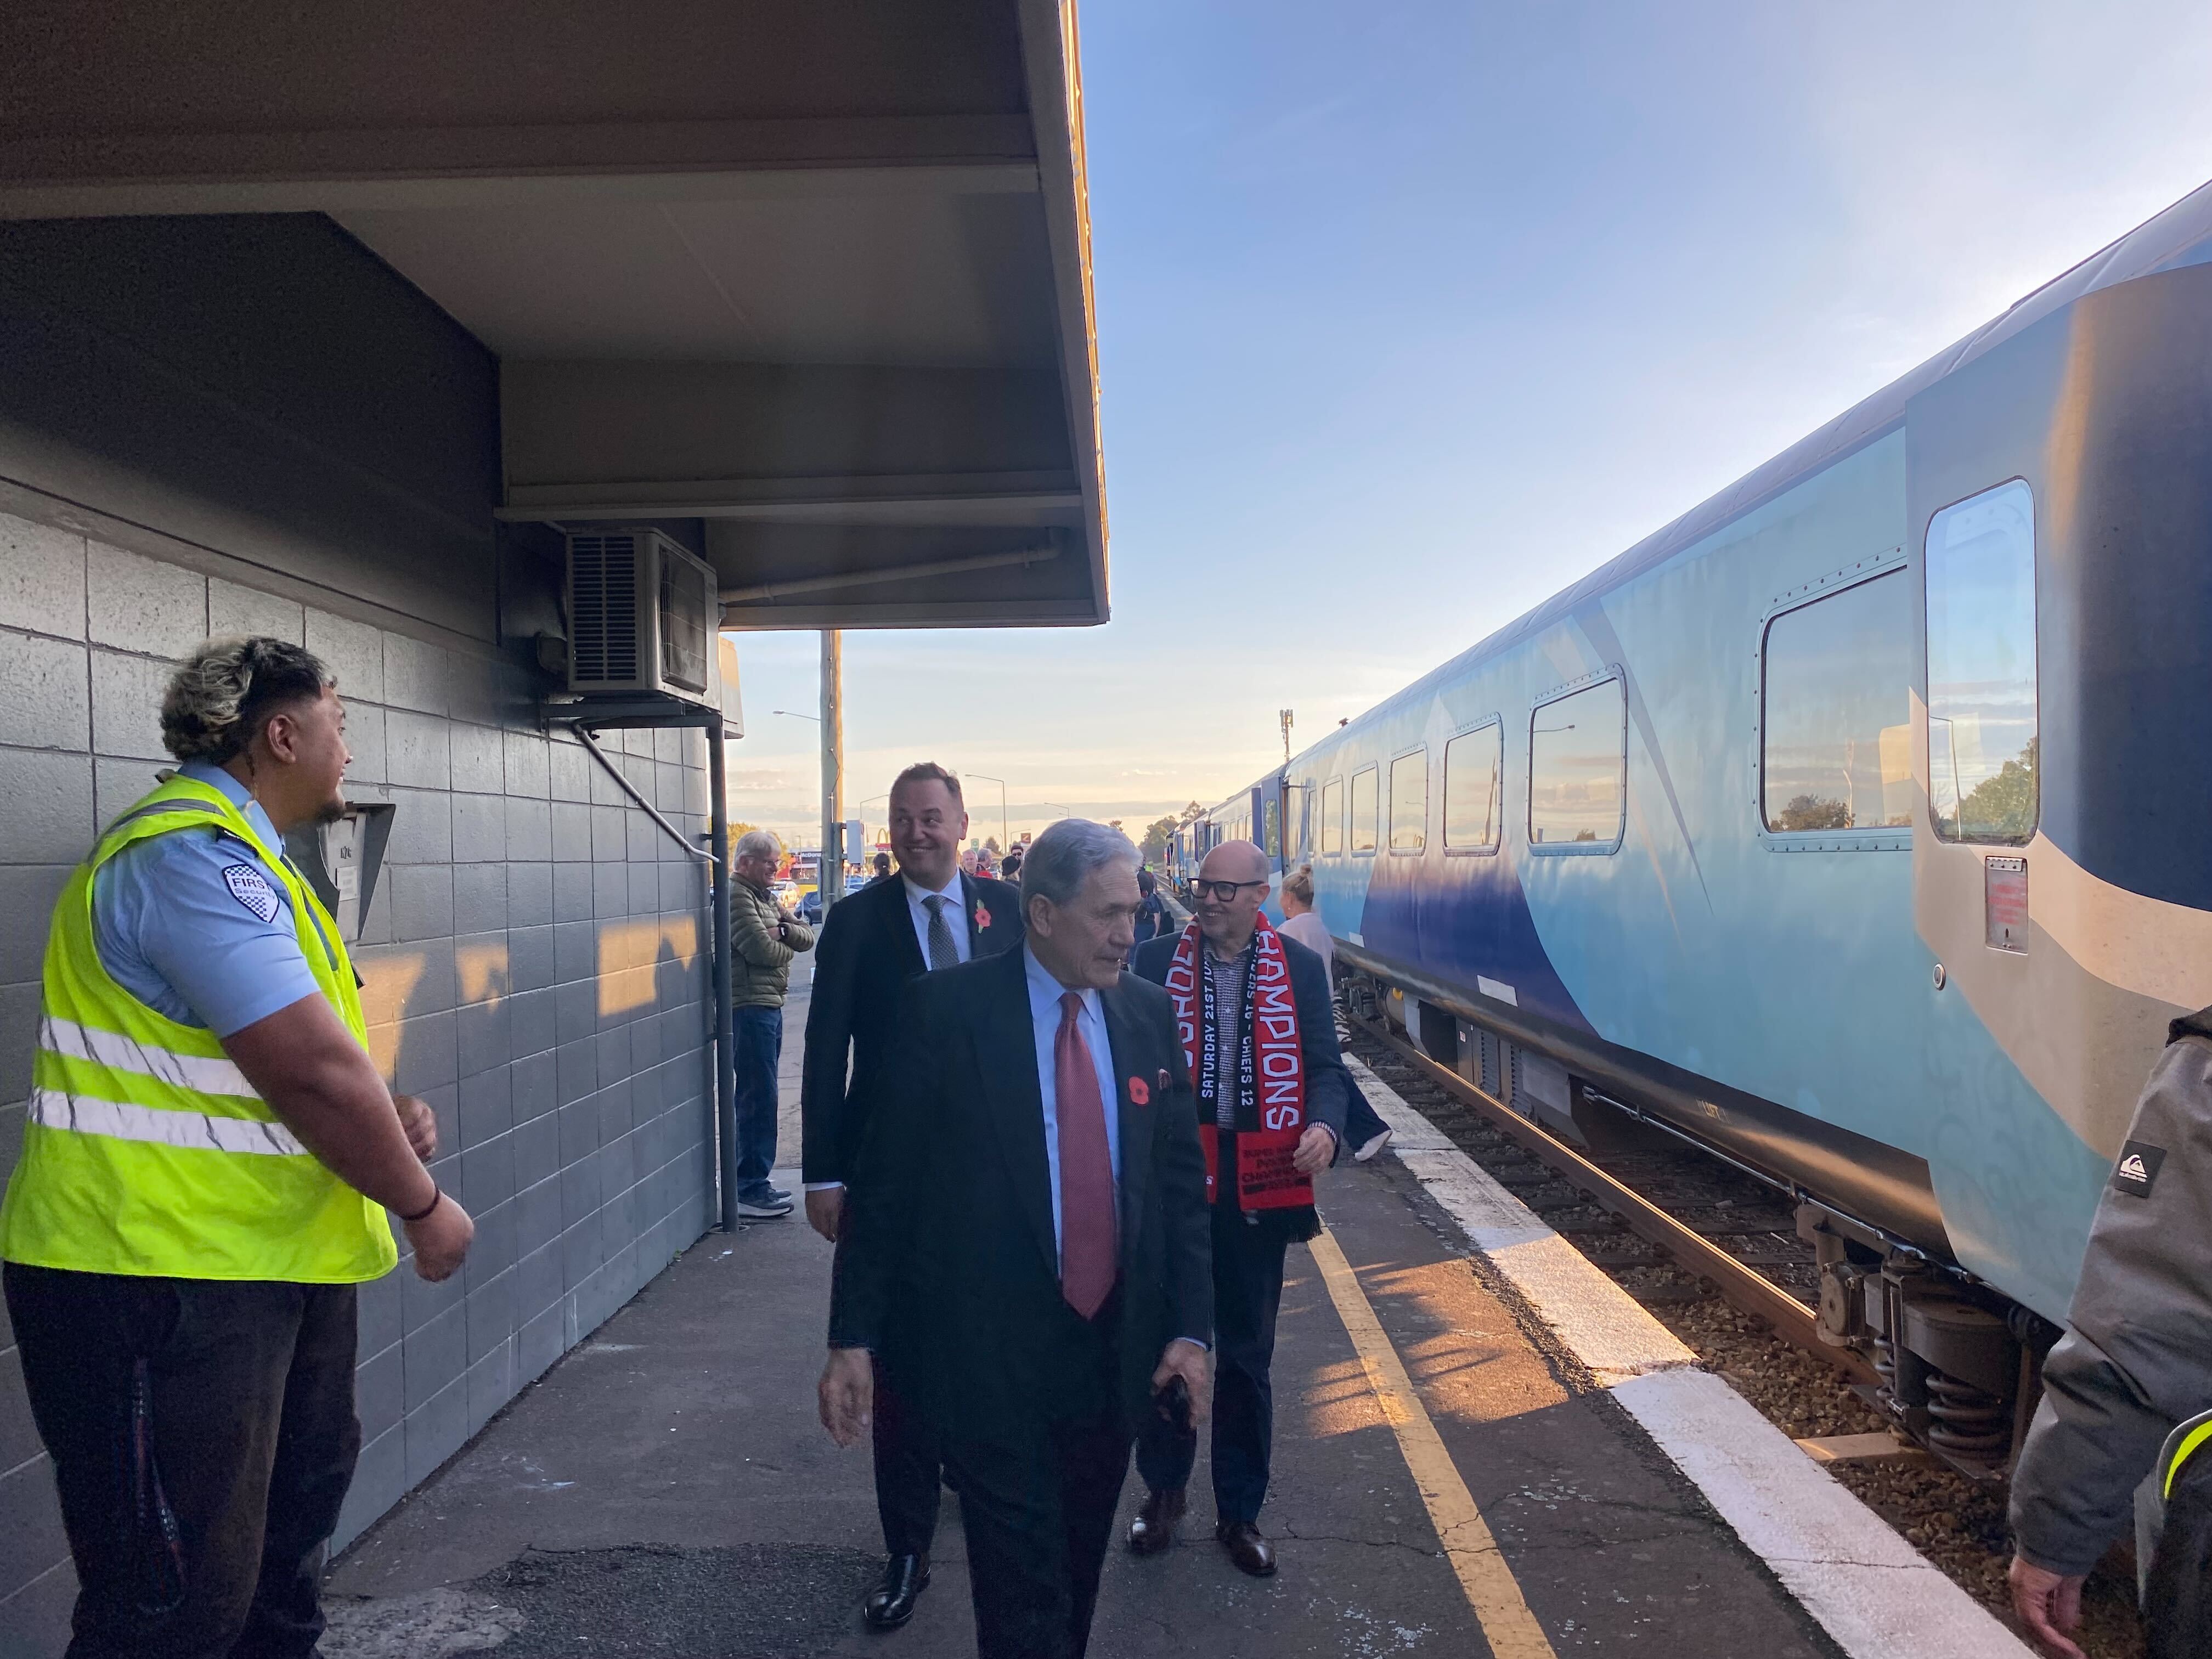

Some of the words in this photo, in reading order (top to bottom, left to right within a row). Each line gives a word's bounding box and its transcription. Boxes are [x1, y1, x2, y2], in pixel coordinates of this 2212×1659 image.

[232, 878, 270, 891] FIRST
[234, 888, 275, 900] Security
[1204, 985, 1214, 1020] 21ST
[1257, 921, 1299, 1131] HAMPIONS
[1201, 1024, 1215, 1098] SATURDAY
[1241, 1036, 1252, 1084] CHIEFS
[1241, 1089, 1254, 1106] 12
